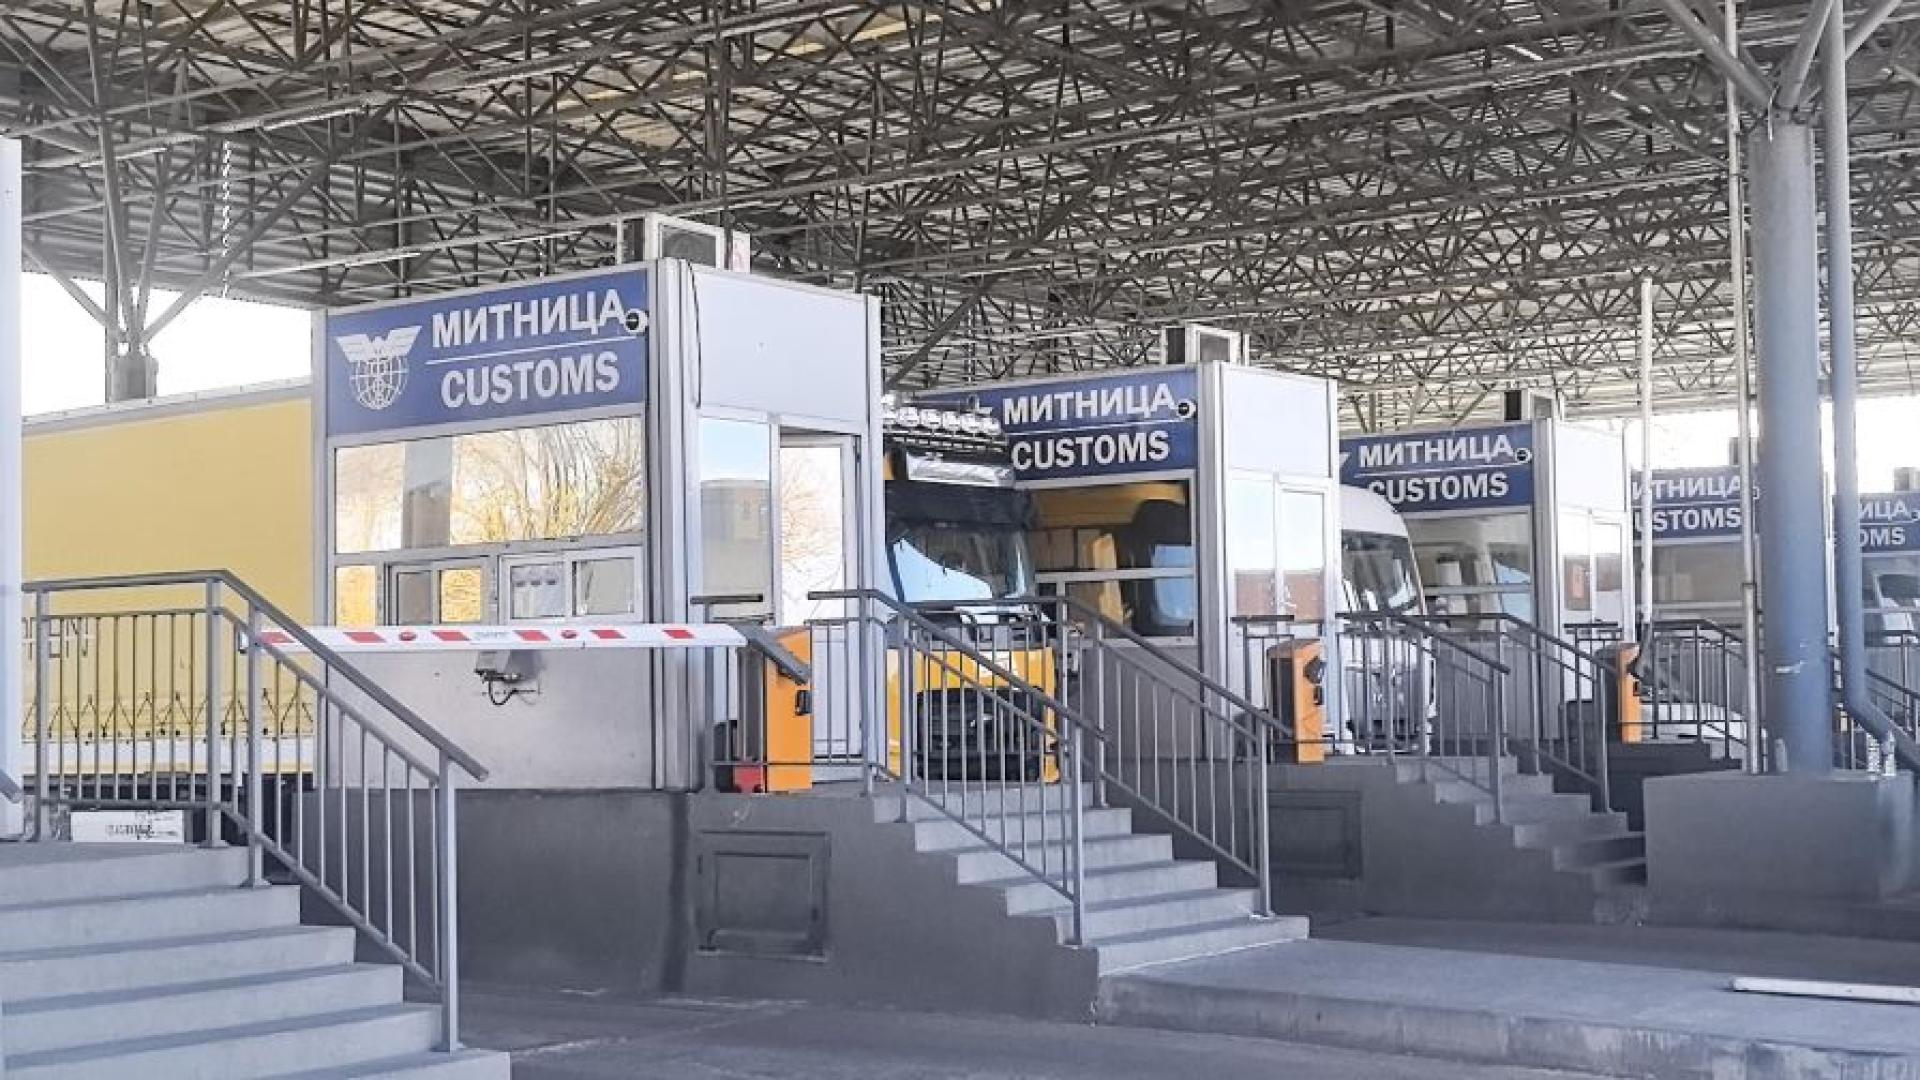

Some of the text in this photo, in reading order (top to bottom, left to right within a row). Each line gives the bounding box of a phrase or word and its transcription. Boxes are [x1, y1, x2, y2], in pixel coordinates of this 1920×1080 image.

[432, 289, 626, 348] МИТНИЦА
[442, 352, 619, 408] CUSTOMS
[1003, 383, 1176, 425] МИТНИЦА
[1011, 430, 1169, 471] CUSTOMS
[1360, 434, 1514, 467] МИТНИЦА
